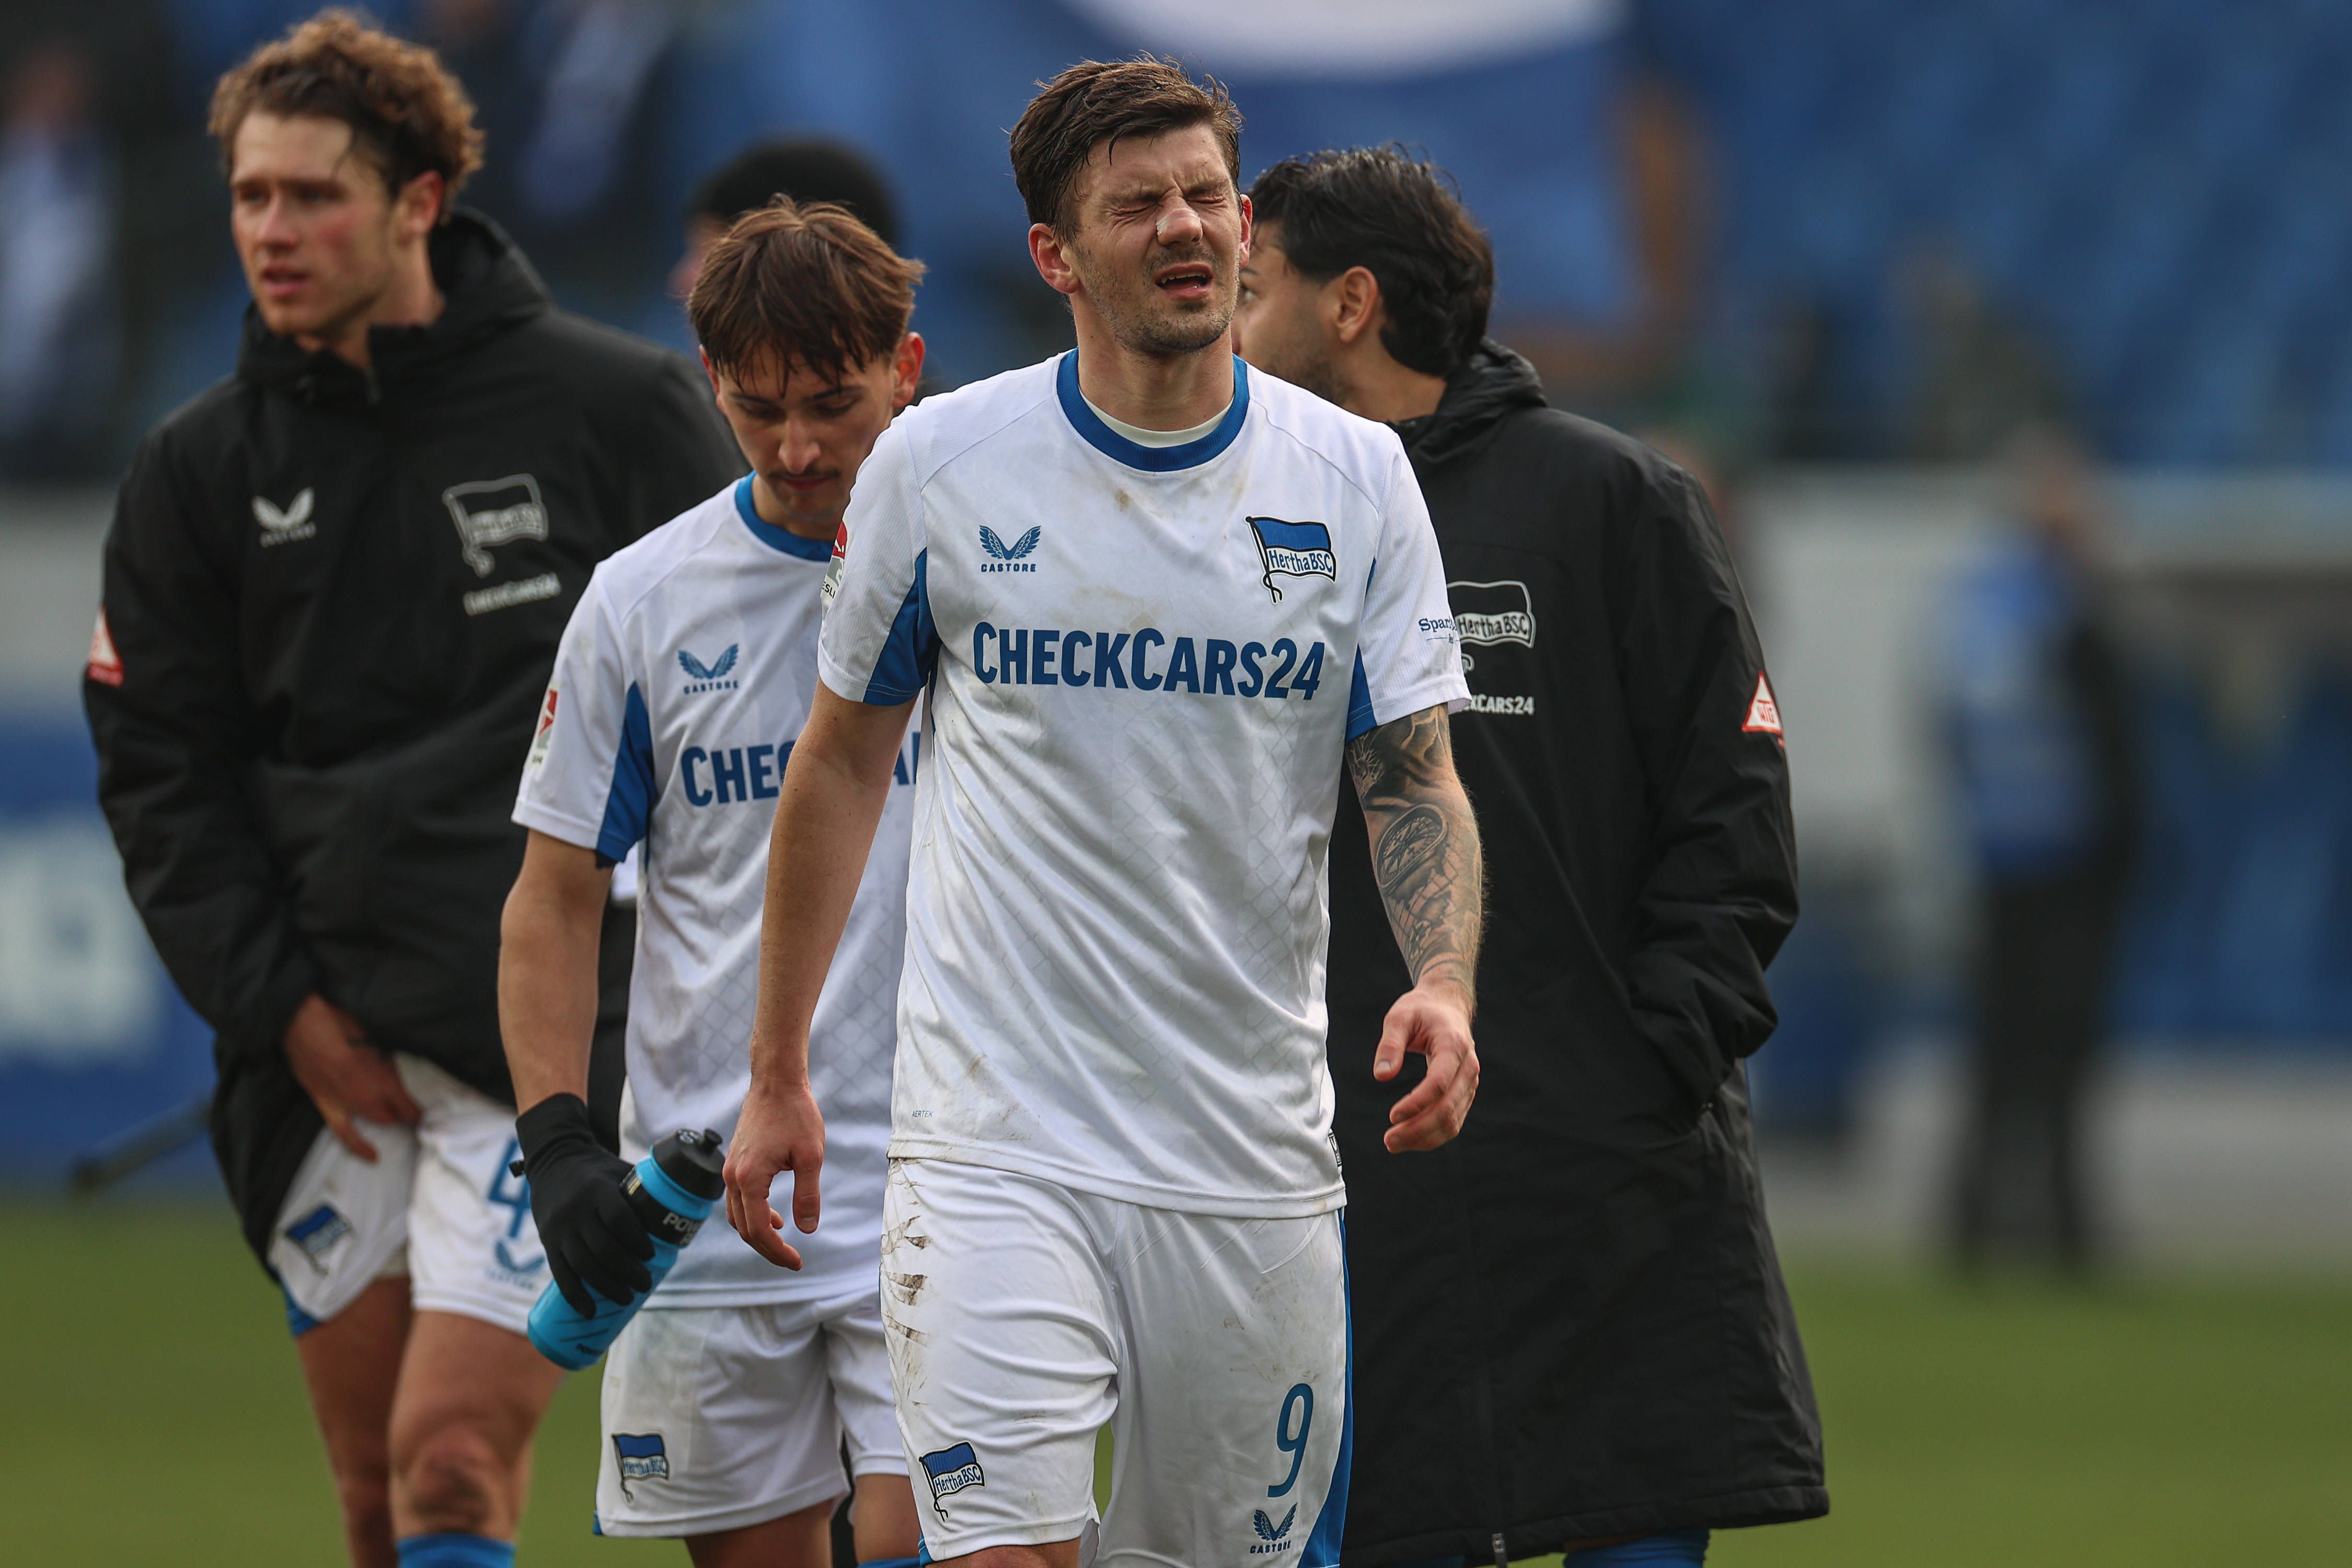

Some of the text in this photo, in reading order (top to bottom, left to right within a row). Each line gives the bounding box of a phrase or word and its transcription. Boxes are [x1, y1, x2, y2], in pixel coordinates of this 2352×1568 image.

[981, 563, 1036, 572] CASTORE
[1418, 616, 1457, 633] Spar
[973, 621, 1325, 701] CHECKCARS24
[684, 680, 739, 695] CASTORE
[1267, 1383, 1313, 1497] 9
[1250, 1540, 1291, 1554] CASTORE
